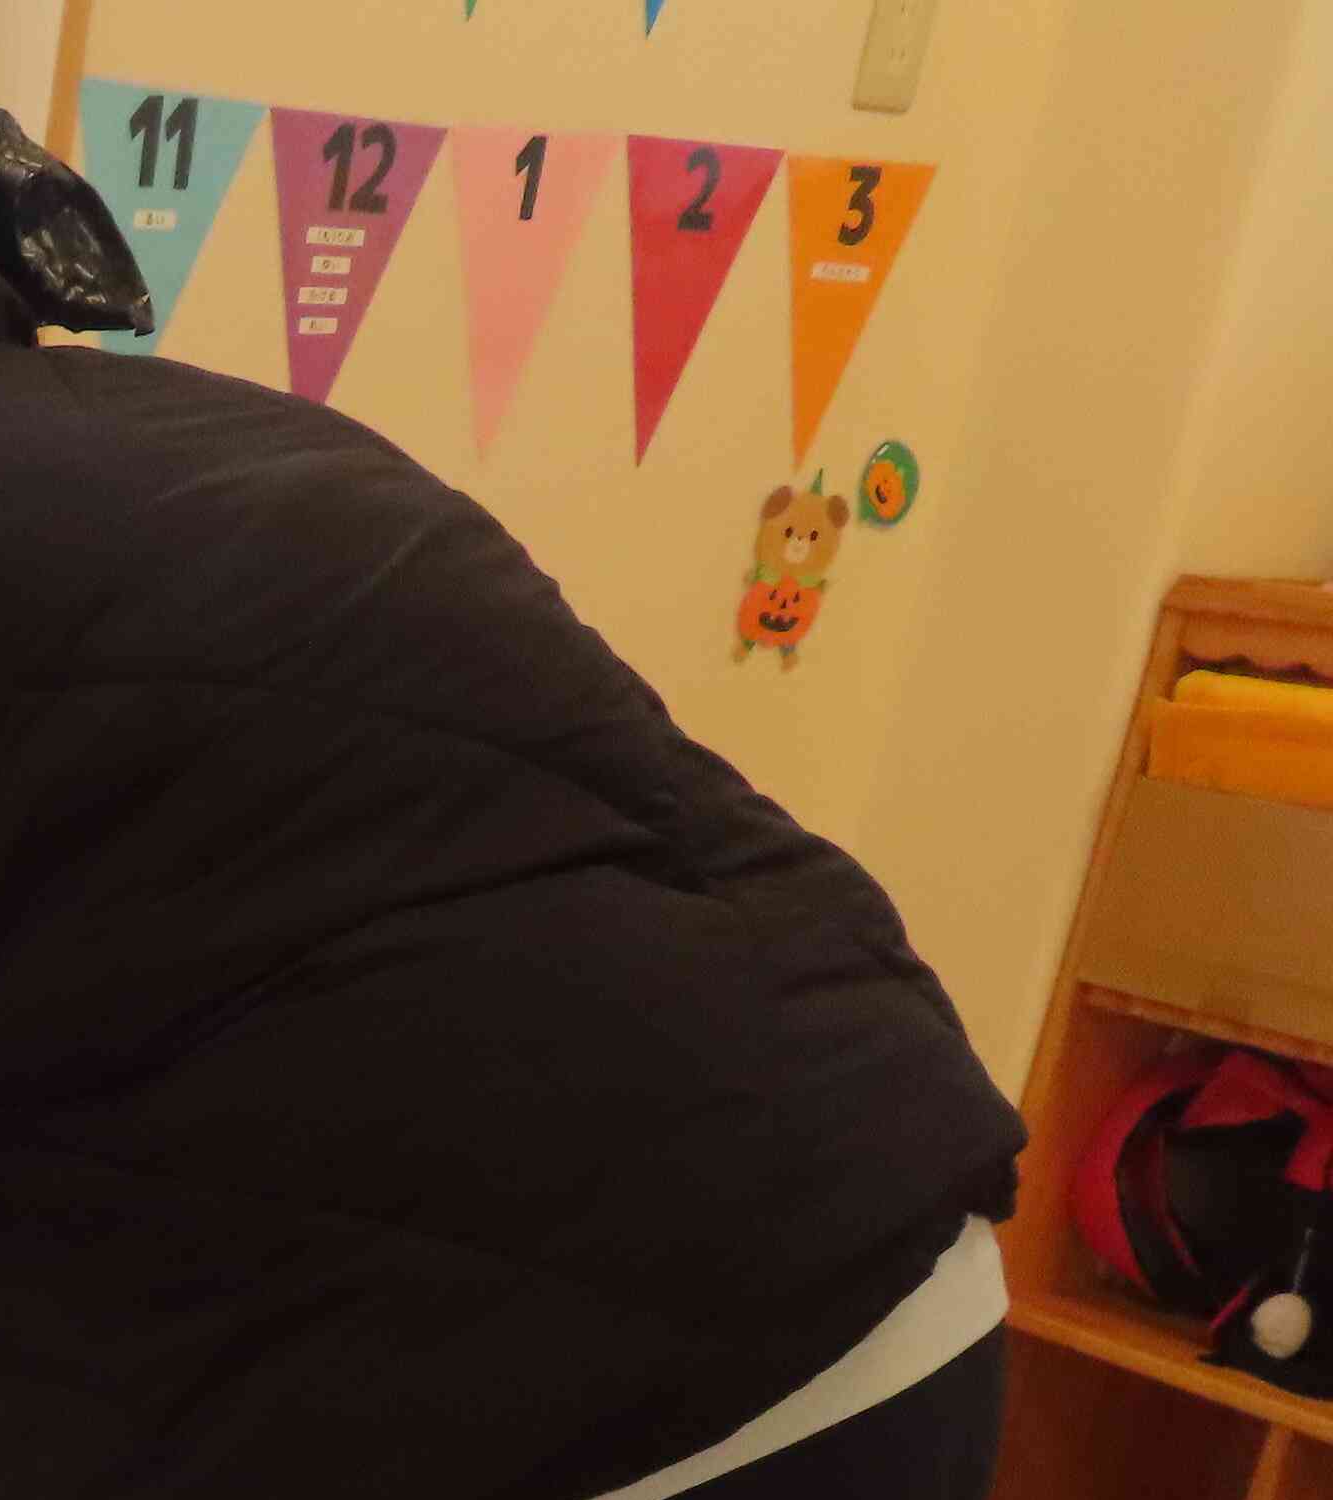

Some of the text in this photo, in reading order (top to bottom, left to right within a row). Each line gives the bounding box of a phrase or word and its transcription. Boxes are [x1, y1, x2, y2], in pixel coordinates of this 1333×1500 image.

[129, 95, 198, 190] 11
[322, 122, 397, 214] 12
[515, 135, 547, 220] 1
[677, 148, 722, 232] 2
[837, 166, 882, 246] 3
